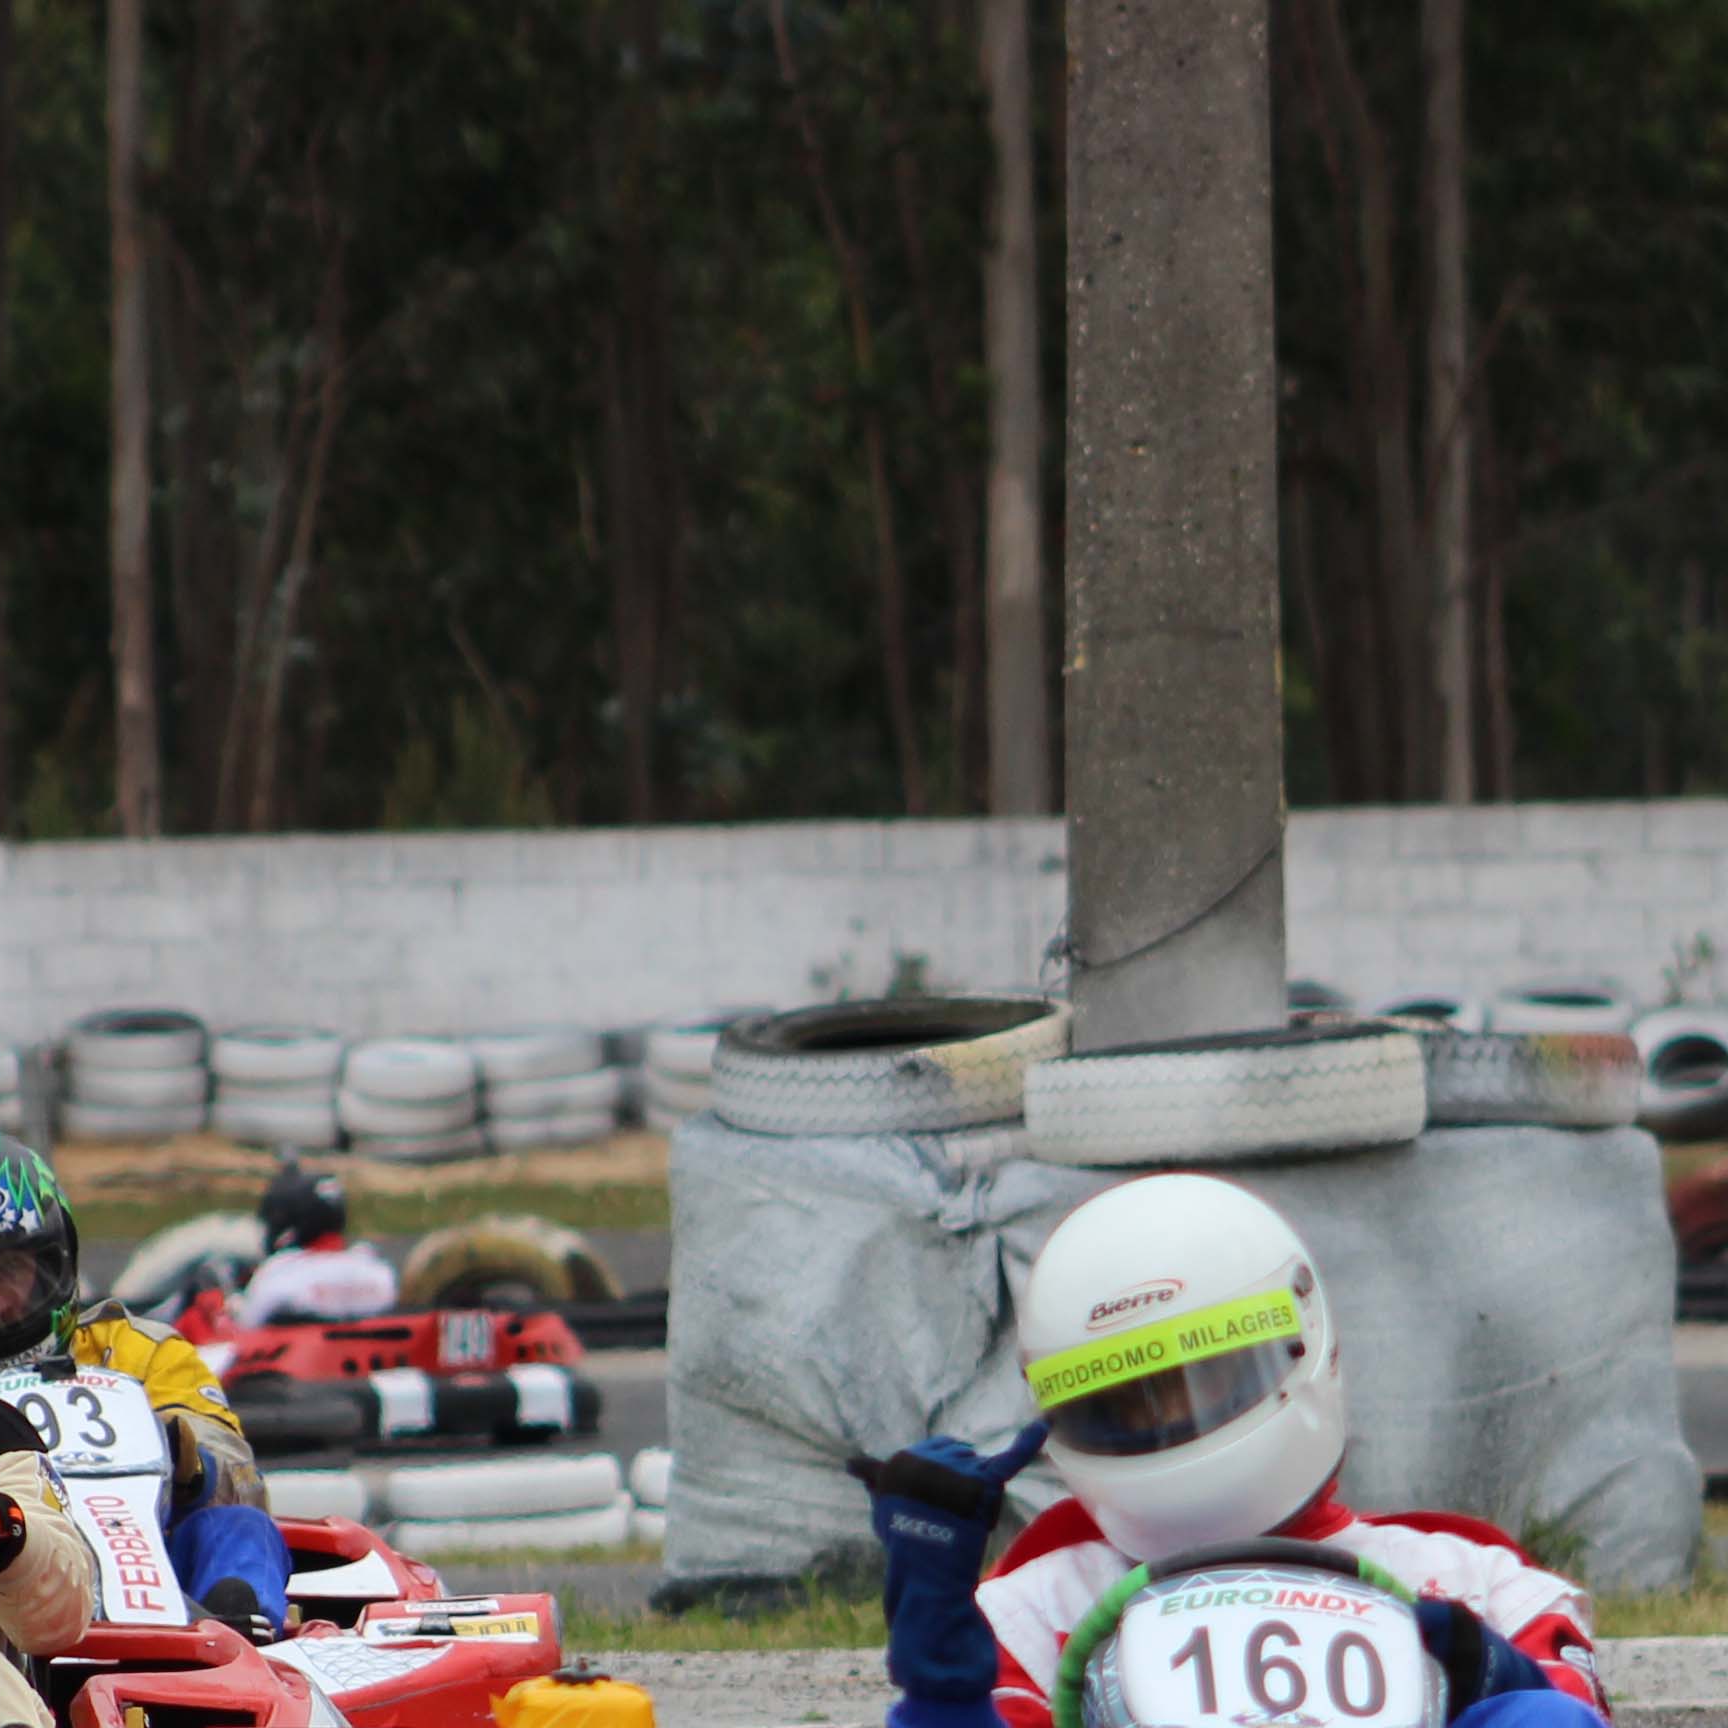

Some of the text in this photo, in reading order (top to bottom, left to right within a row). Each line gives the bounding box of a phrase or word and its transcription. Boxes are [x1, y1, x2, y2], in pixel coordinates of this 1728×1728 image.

[1034, 1304, 1294, 1400] ARTODROMO MILAGRES
[84, 1495, 166, 1612] FERBERTO
[1160, 1587, 1373, 1616] EUROINDY
[1170, 1619, 1387, 1719] 160
